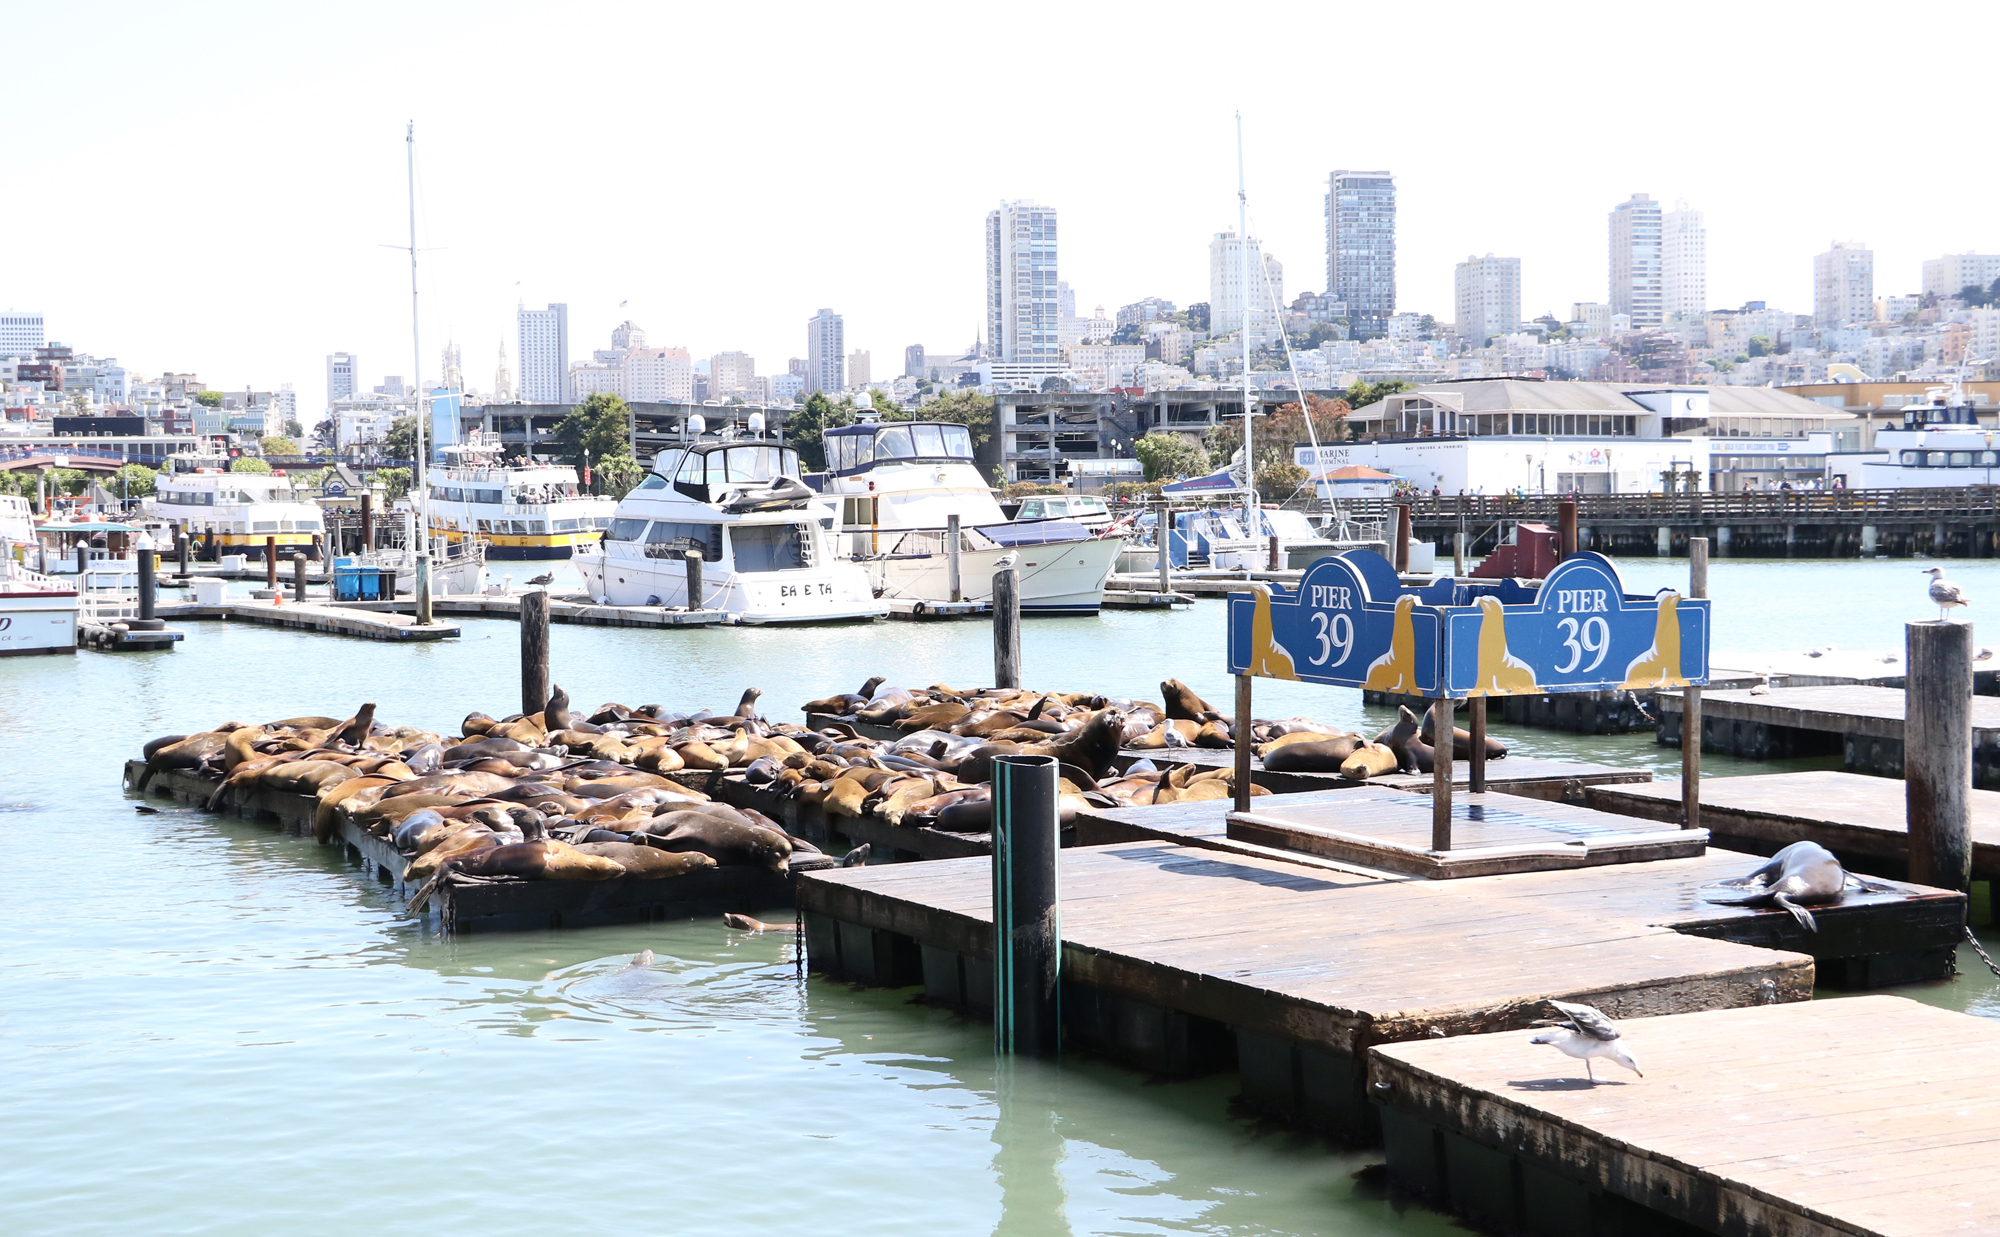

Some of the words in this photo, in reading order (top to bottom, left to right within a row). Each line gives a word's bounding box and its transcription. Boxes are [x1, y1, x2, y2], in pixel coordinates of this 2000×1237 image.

[1304, 453, 1314, 463] 41
[1310, 584, 1353, 610] PIER
[1557, 589, 1608, 614] PIER
[1308, 611, 1355, 668] 39
[1554, 616, 1611, 674] 39
